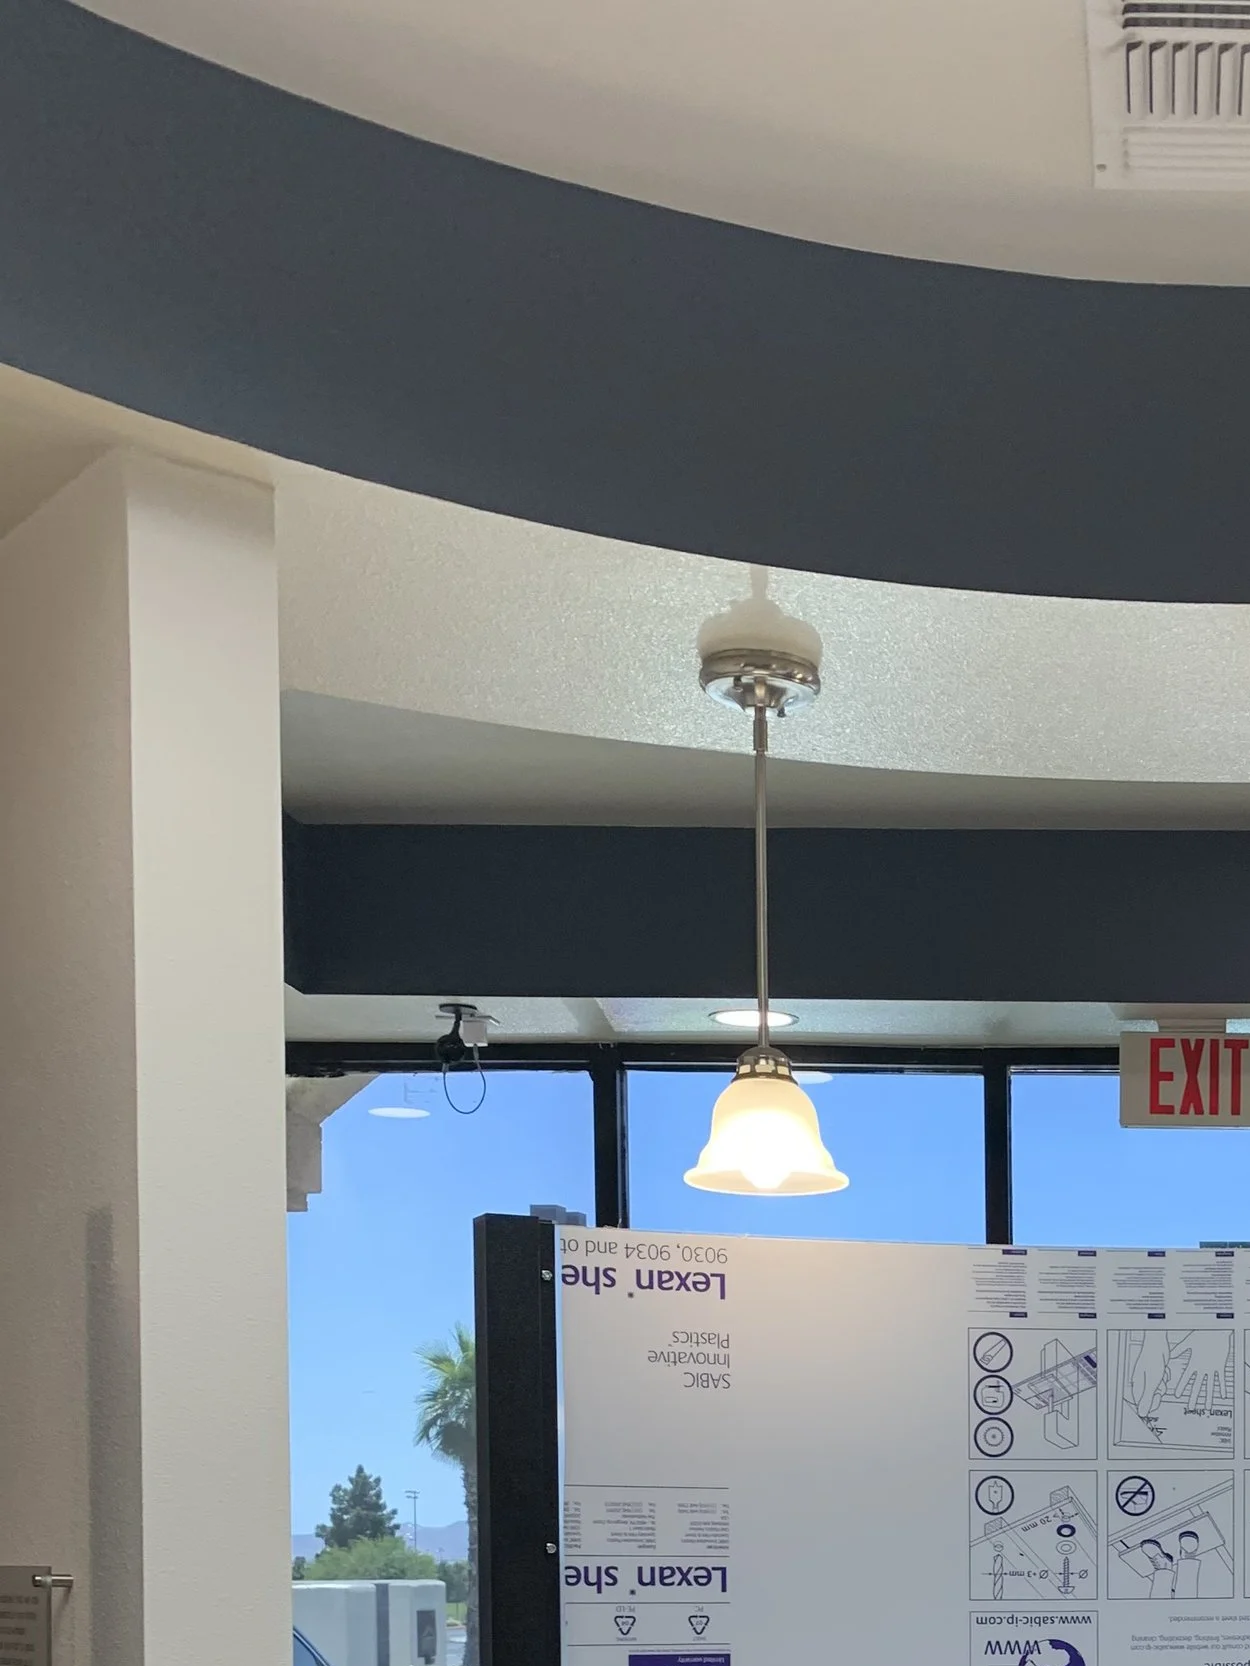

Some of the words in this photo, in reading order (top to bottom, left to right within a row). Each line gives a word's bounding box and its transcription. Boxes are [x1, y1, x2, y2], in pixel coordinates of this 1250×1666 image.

[1150, 1038, 1249, 1115] EXIT
[585, 1240, 618, 1256] and
[624, 1243, 671, 1261] 9034
[677, 1244, 729, 1264] 9030,
[648, 1348, 731, 1368] Innovative
[684, 1372, 731, 1389] SABIC
[976, 1614, 1092, 1627] www.sabic-ip.com
